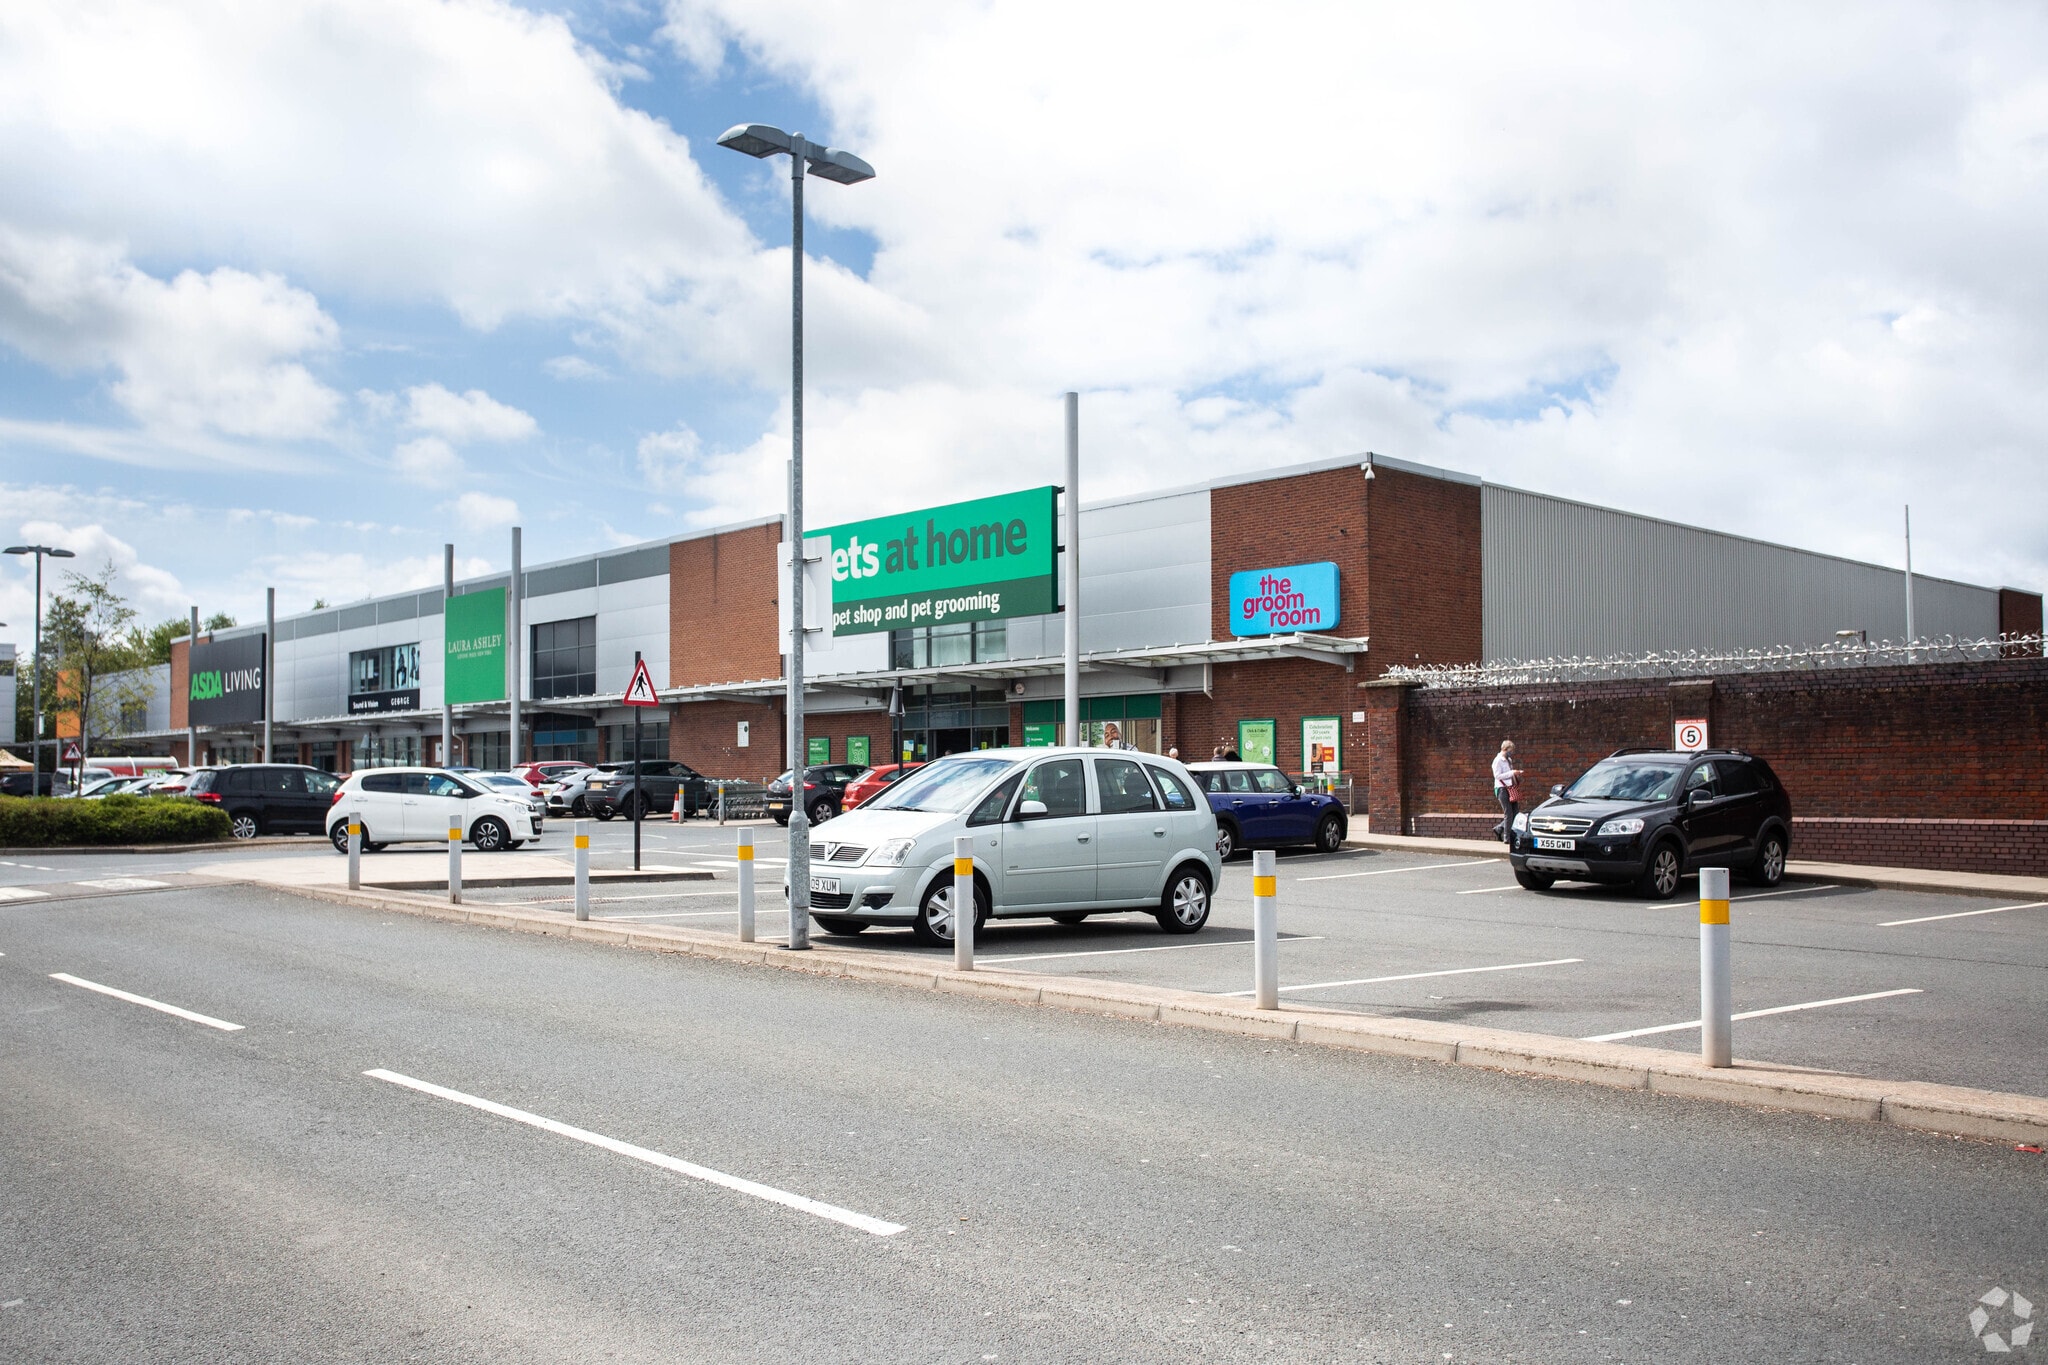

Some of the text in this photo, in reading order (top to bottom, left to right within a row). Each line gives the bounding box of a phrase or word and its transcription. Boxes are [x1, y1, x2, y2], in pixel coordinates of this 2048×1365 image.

[831, 518, 1027, 581] ets at home
[1259, 574, 1291, 596] the
[832, 590, 1001, 631] pet shop and pet grooming
[1243, 592, 1304, 619] groom
[1270, 607, 1320, 627] room
[448, 634, 502, 654] LAURA ASHLEY
[190, 667, 261, 701] ASDA LIVING
[352, 701, 364, 710] Sound
[390, 696, 410, 706] GEORGE
[1687, 730, 1696, 743] 5
[1540, 839, 1572, 849] X55 GWD
[810, 878, 837, 892] 09 XUM
